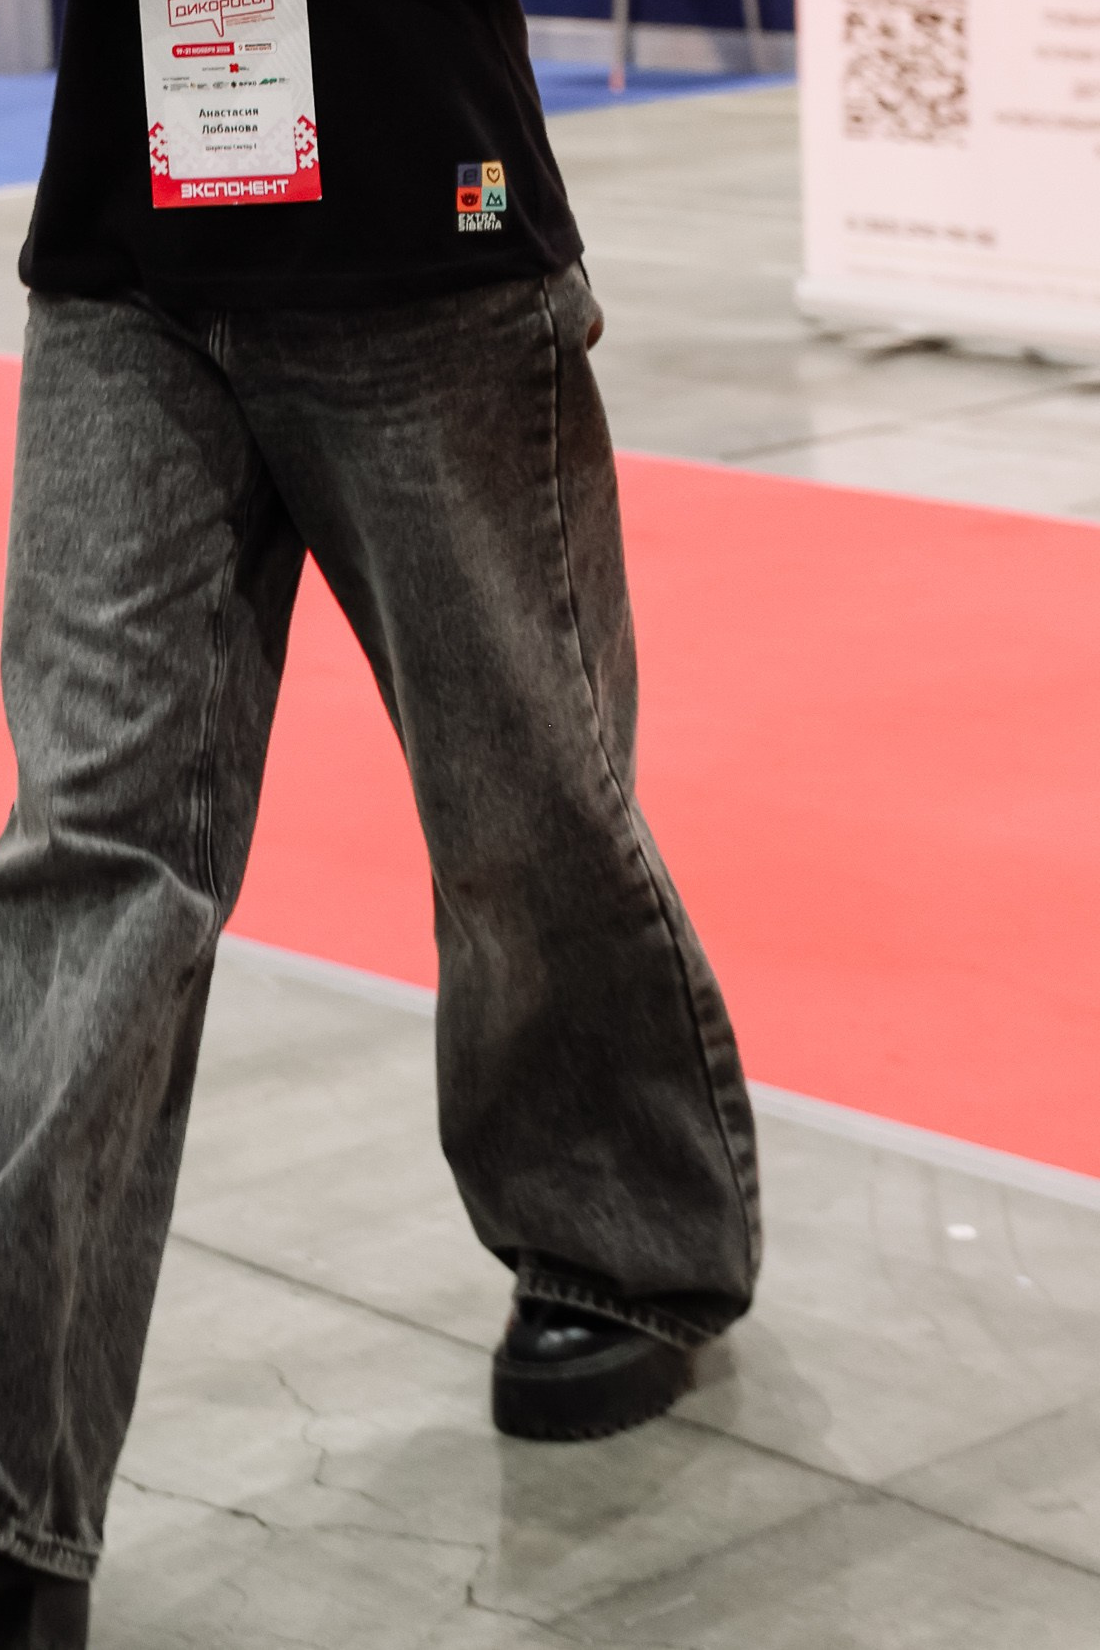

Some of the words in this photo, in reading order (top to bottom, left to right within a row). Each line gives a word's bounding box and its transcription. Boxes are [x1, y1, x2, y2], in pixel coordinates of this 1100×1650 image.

[199, 108, 259, 118] Анастасия
[202, 123, 258, 134] Лобанова
[181, 179, 289, 198] ЭКСПОНЕНТ
